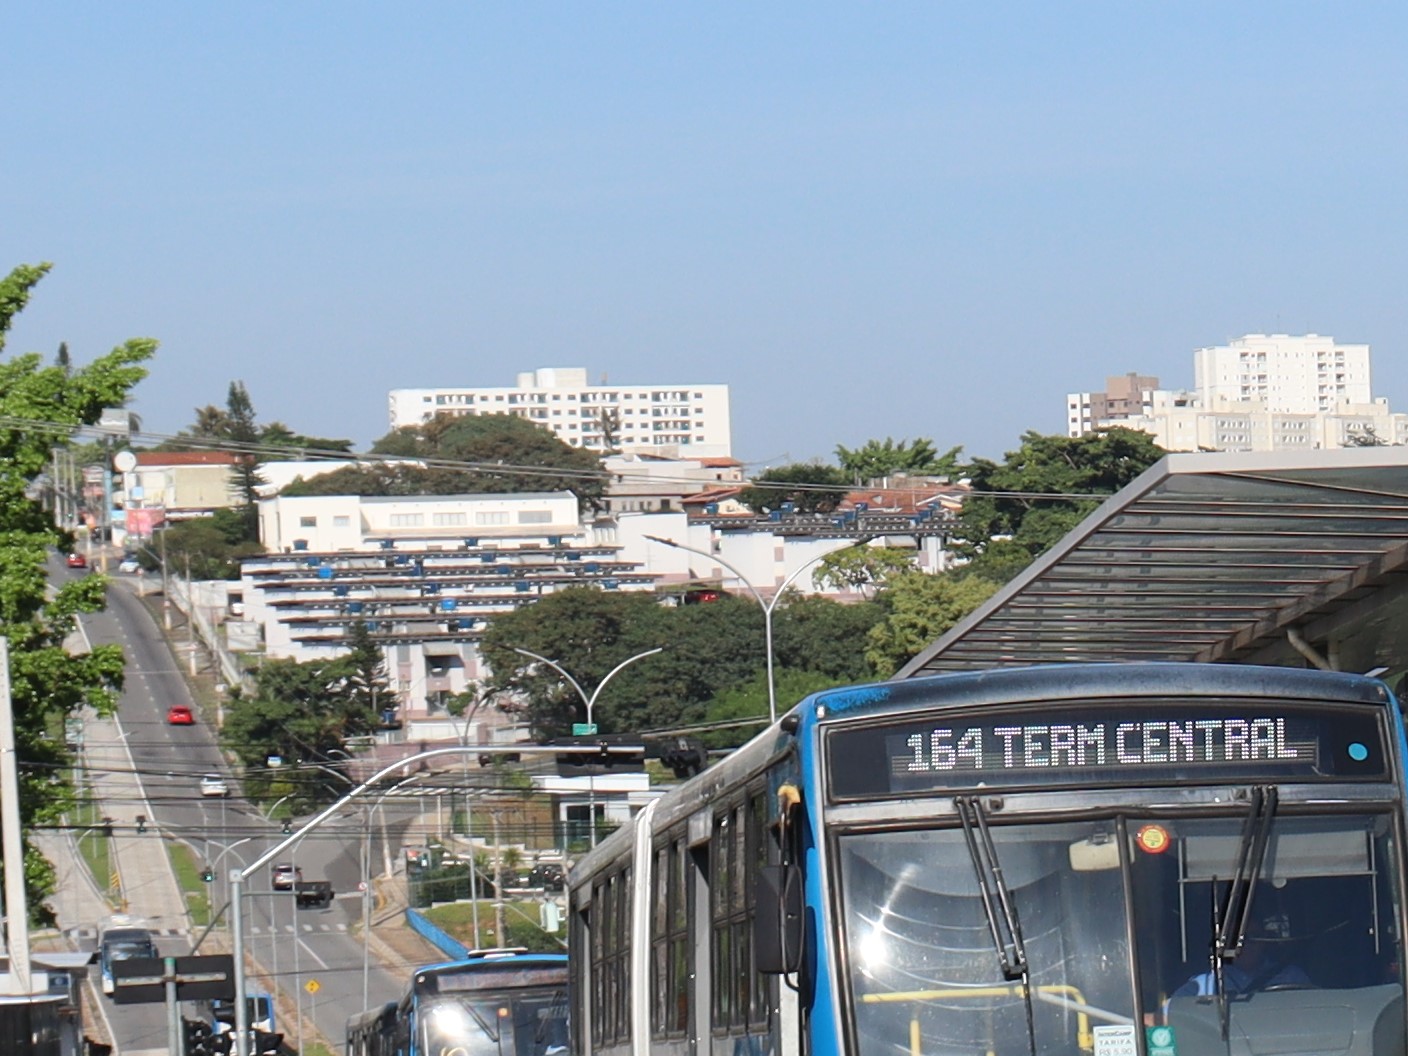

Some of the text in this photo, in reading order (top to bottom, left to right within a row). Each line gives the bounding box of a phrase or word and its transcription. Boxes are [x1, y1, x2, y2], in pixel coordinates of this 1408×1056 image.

[907, 716, 1299, 772] 164 TERM CENTRAL
